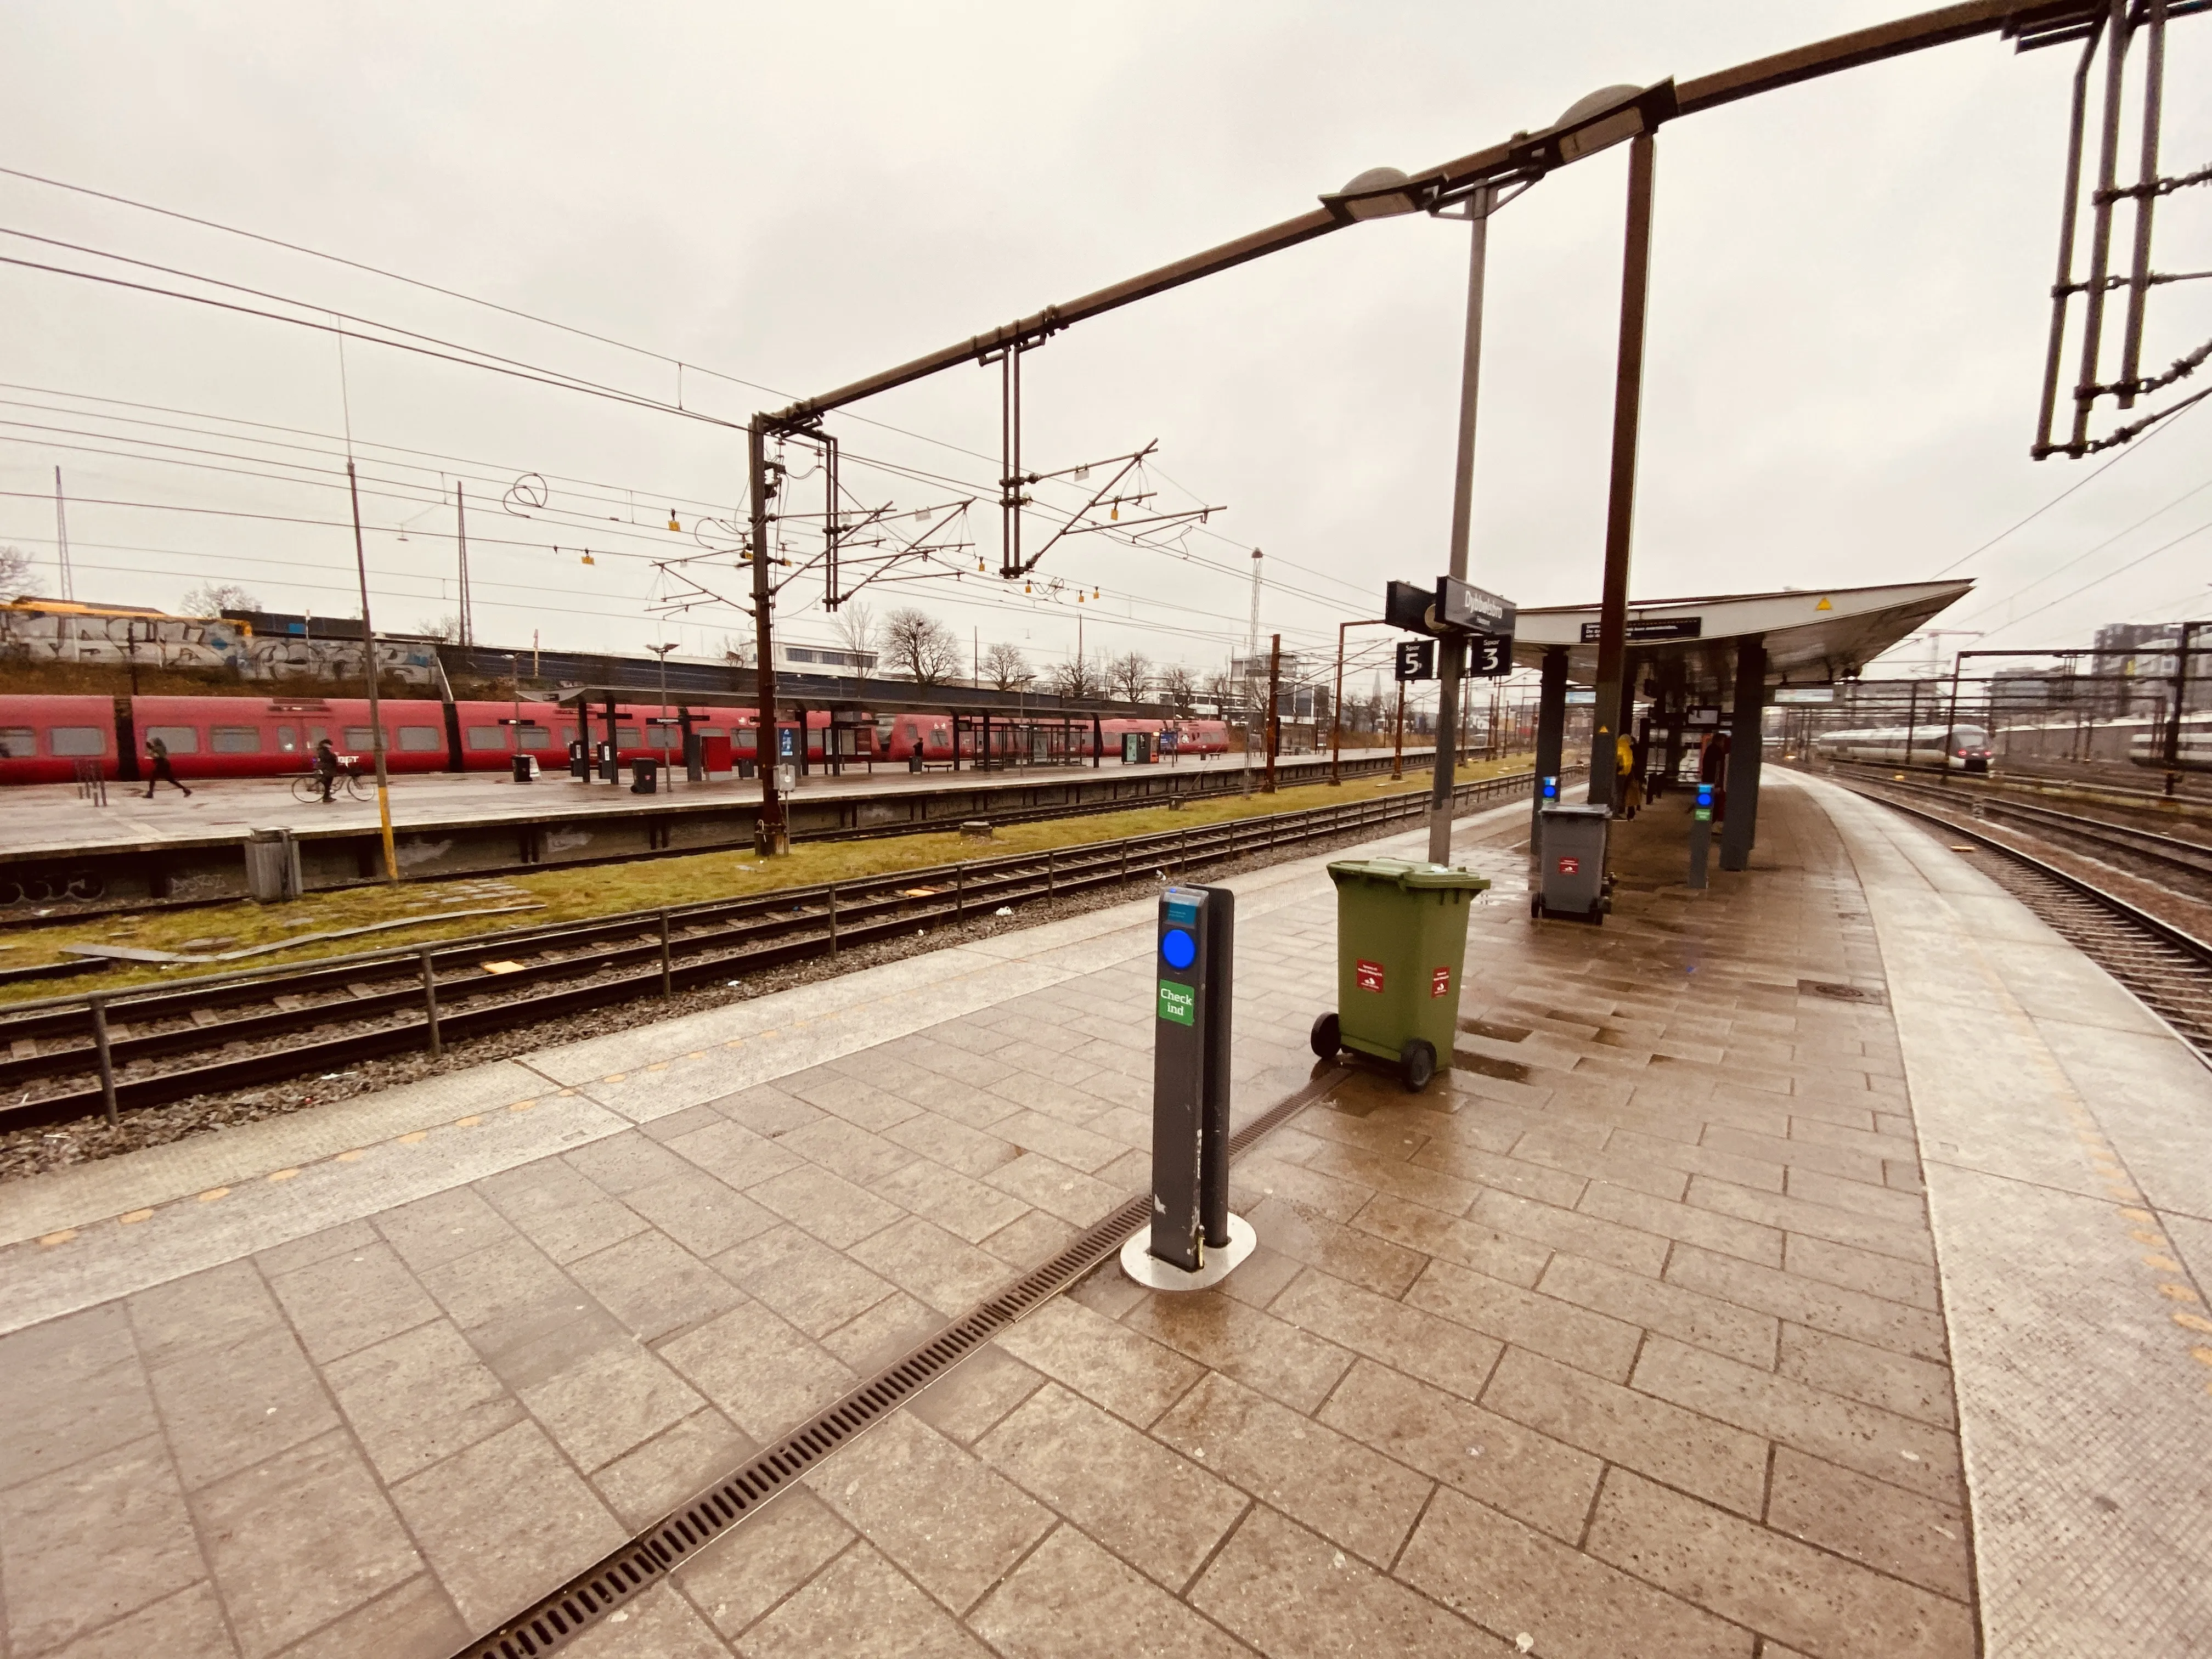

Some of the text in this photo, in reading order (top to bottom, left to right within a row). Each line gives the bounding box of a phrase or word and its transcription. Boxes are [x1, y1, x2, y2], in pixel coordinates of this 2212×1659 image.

[1404, 653, 1419, 674] 5
[1482, 648, 1499, 670] 3
[1160, 988, 1193, 1006] Check
[1167, 1001, 1184, 1016] ind
